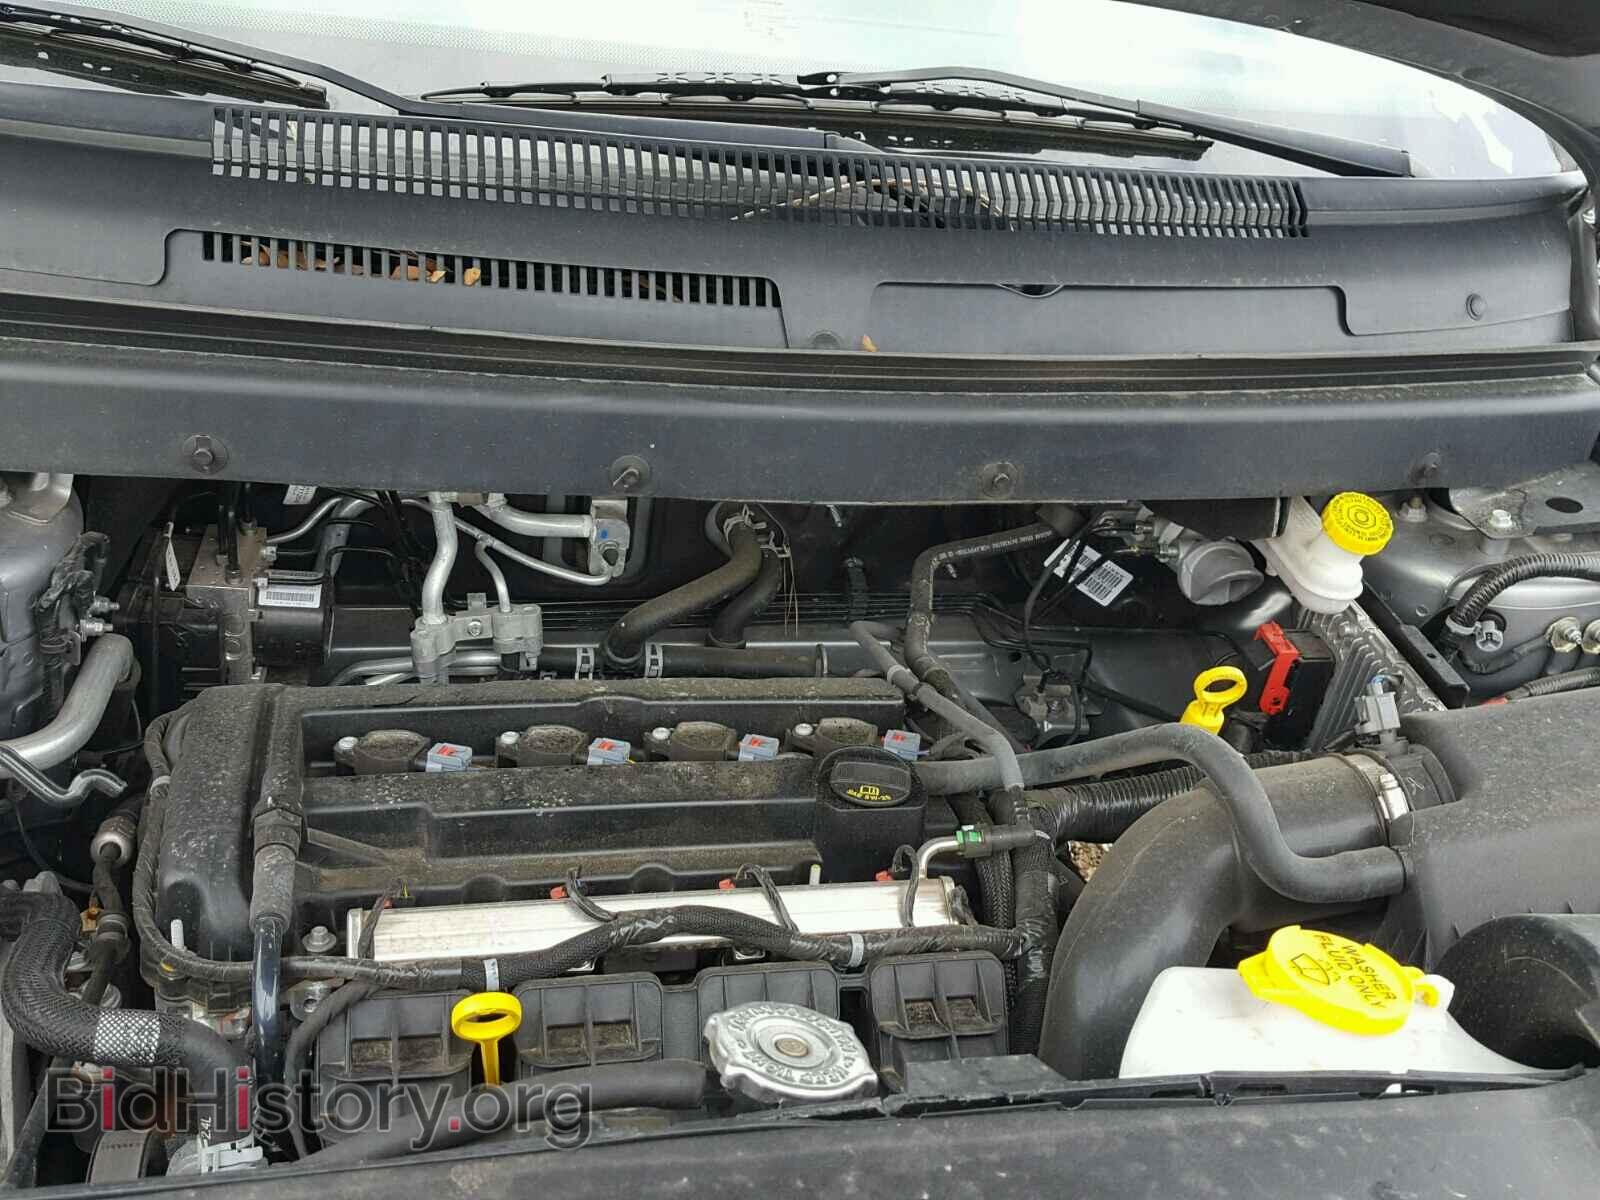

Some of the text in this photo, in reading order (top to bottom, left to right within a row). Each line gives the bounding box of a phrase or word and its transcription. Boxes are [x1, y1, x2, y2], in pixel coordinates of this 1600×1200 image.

[1314, 934, 1387, 1010] FLUID ONLY
[1342, 944, 1398, 1001] WASHER
